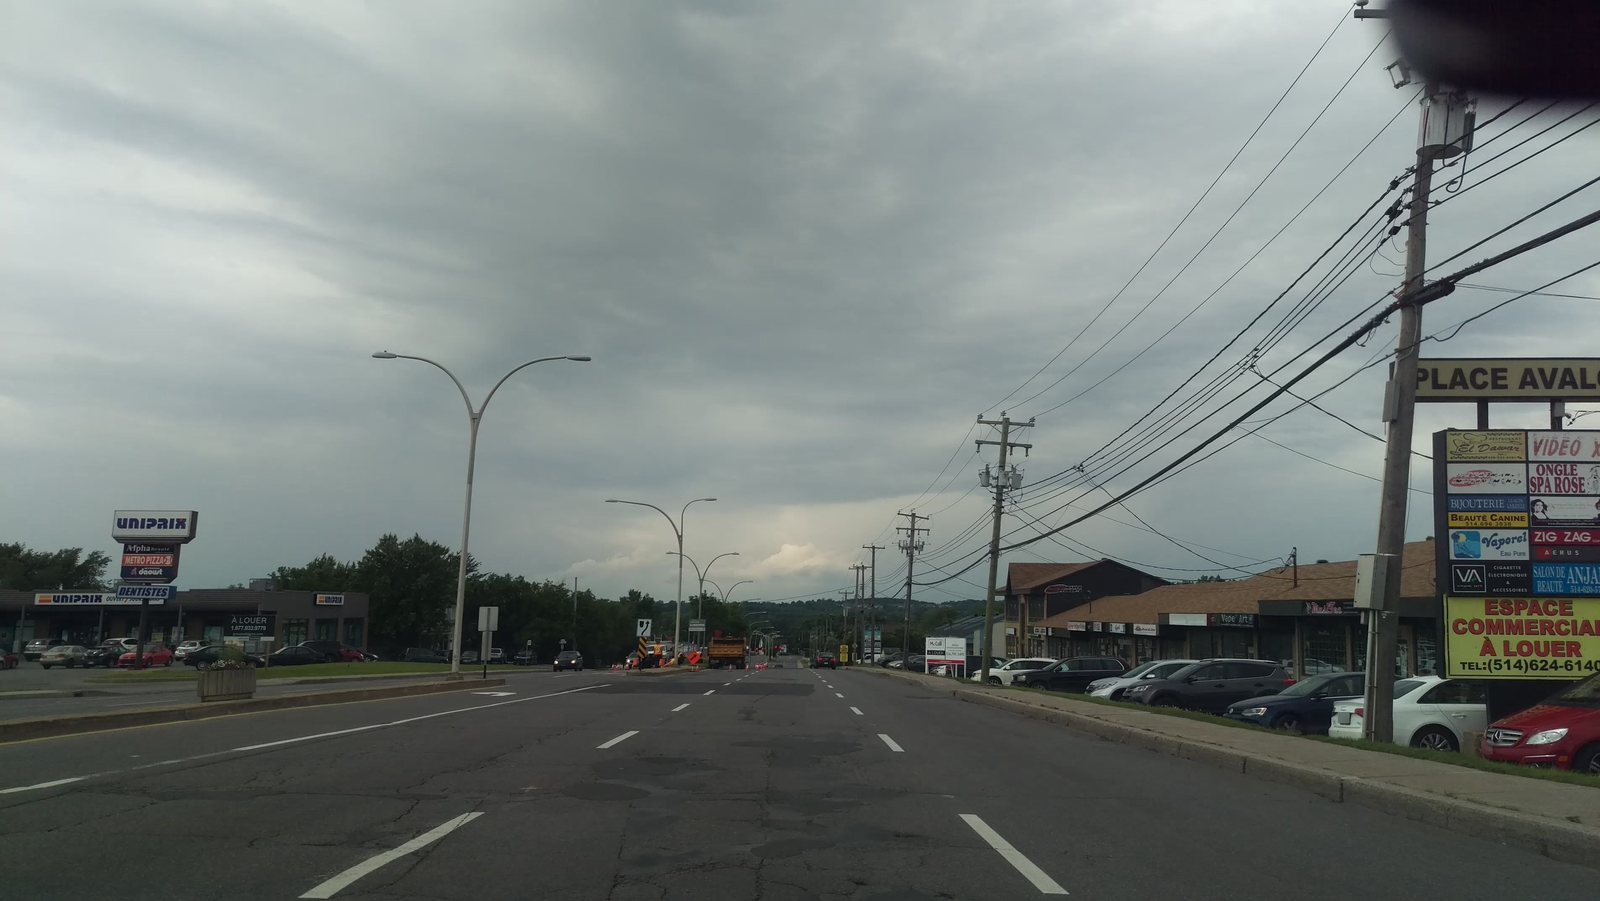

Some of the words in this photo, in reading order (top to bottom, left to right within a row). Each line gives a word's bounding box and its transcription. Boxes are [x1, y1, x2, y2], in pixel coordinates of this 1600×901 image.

[1416, 368, 1508, 390] PLACE
[1518, 368, 1600, 390] AVAL
[1478, 444, 1520, 453] Dawar
[1533, 439, 1582, 457] VIDEO
[1536, 464, 1578, 476] ONGLE
[1530, 477, 1552, 493] SPA
[1554, 477, 1586, 493] ROSE
[1451, 499, 1504, 510] BIJOUTERIE
[117, 517, 187, 529] UNIPRIX
[1490, 513, 1526, 522] CANINE
[1534, 532, 1557, 542] ZIG
[1564, 532, 1592, 543] ZAG
[125, 556, 146, 565] METRO
[146, 556, 164, 565] PIZZA
[1533, 566, 1555, 578] SALON
[1556, 567, 1566, 578] DE
[1567, 567, 1600, 583] ANJA
[118, 587, 168, 597] DENTISTES
[53, 595, 102, 603] UNIPRIX
[1484, 599, 1574, 616] ESPACE
[239, 616, 267, 624] LOUER
[1221, 613, 1236, 623] Vape
[1238, 614, 1249, 624] Art
[1479, 636, 1497, 657] À
[1503, 640, 1582, 658] LOUER
